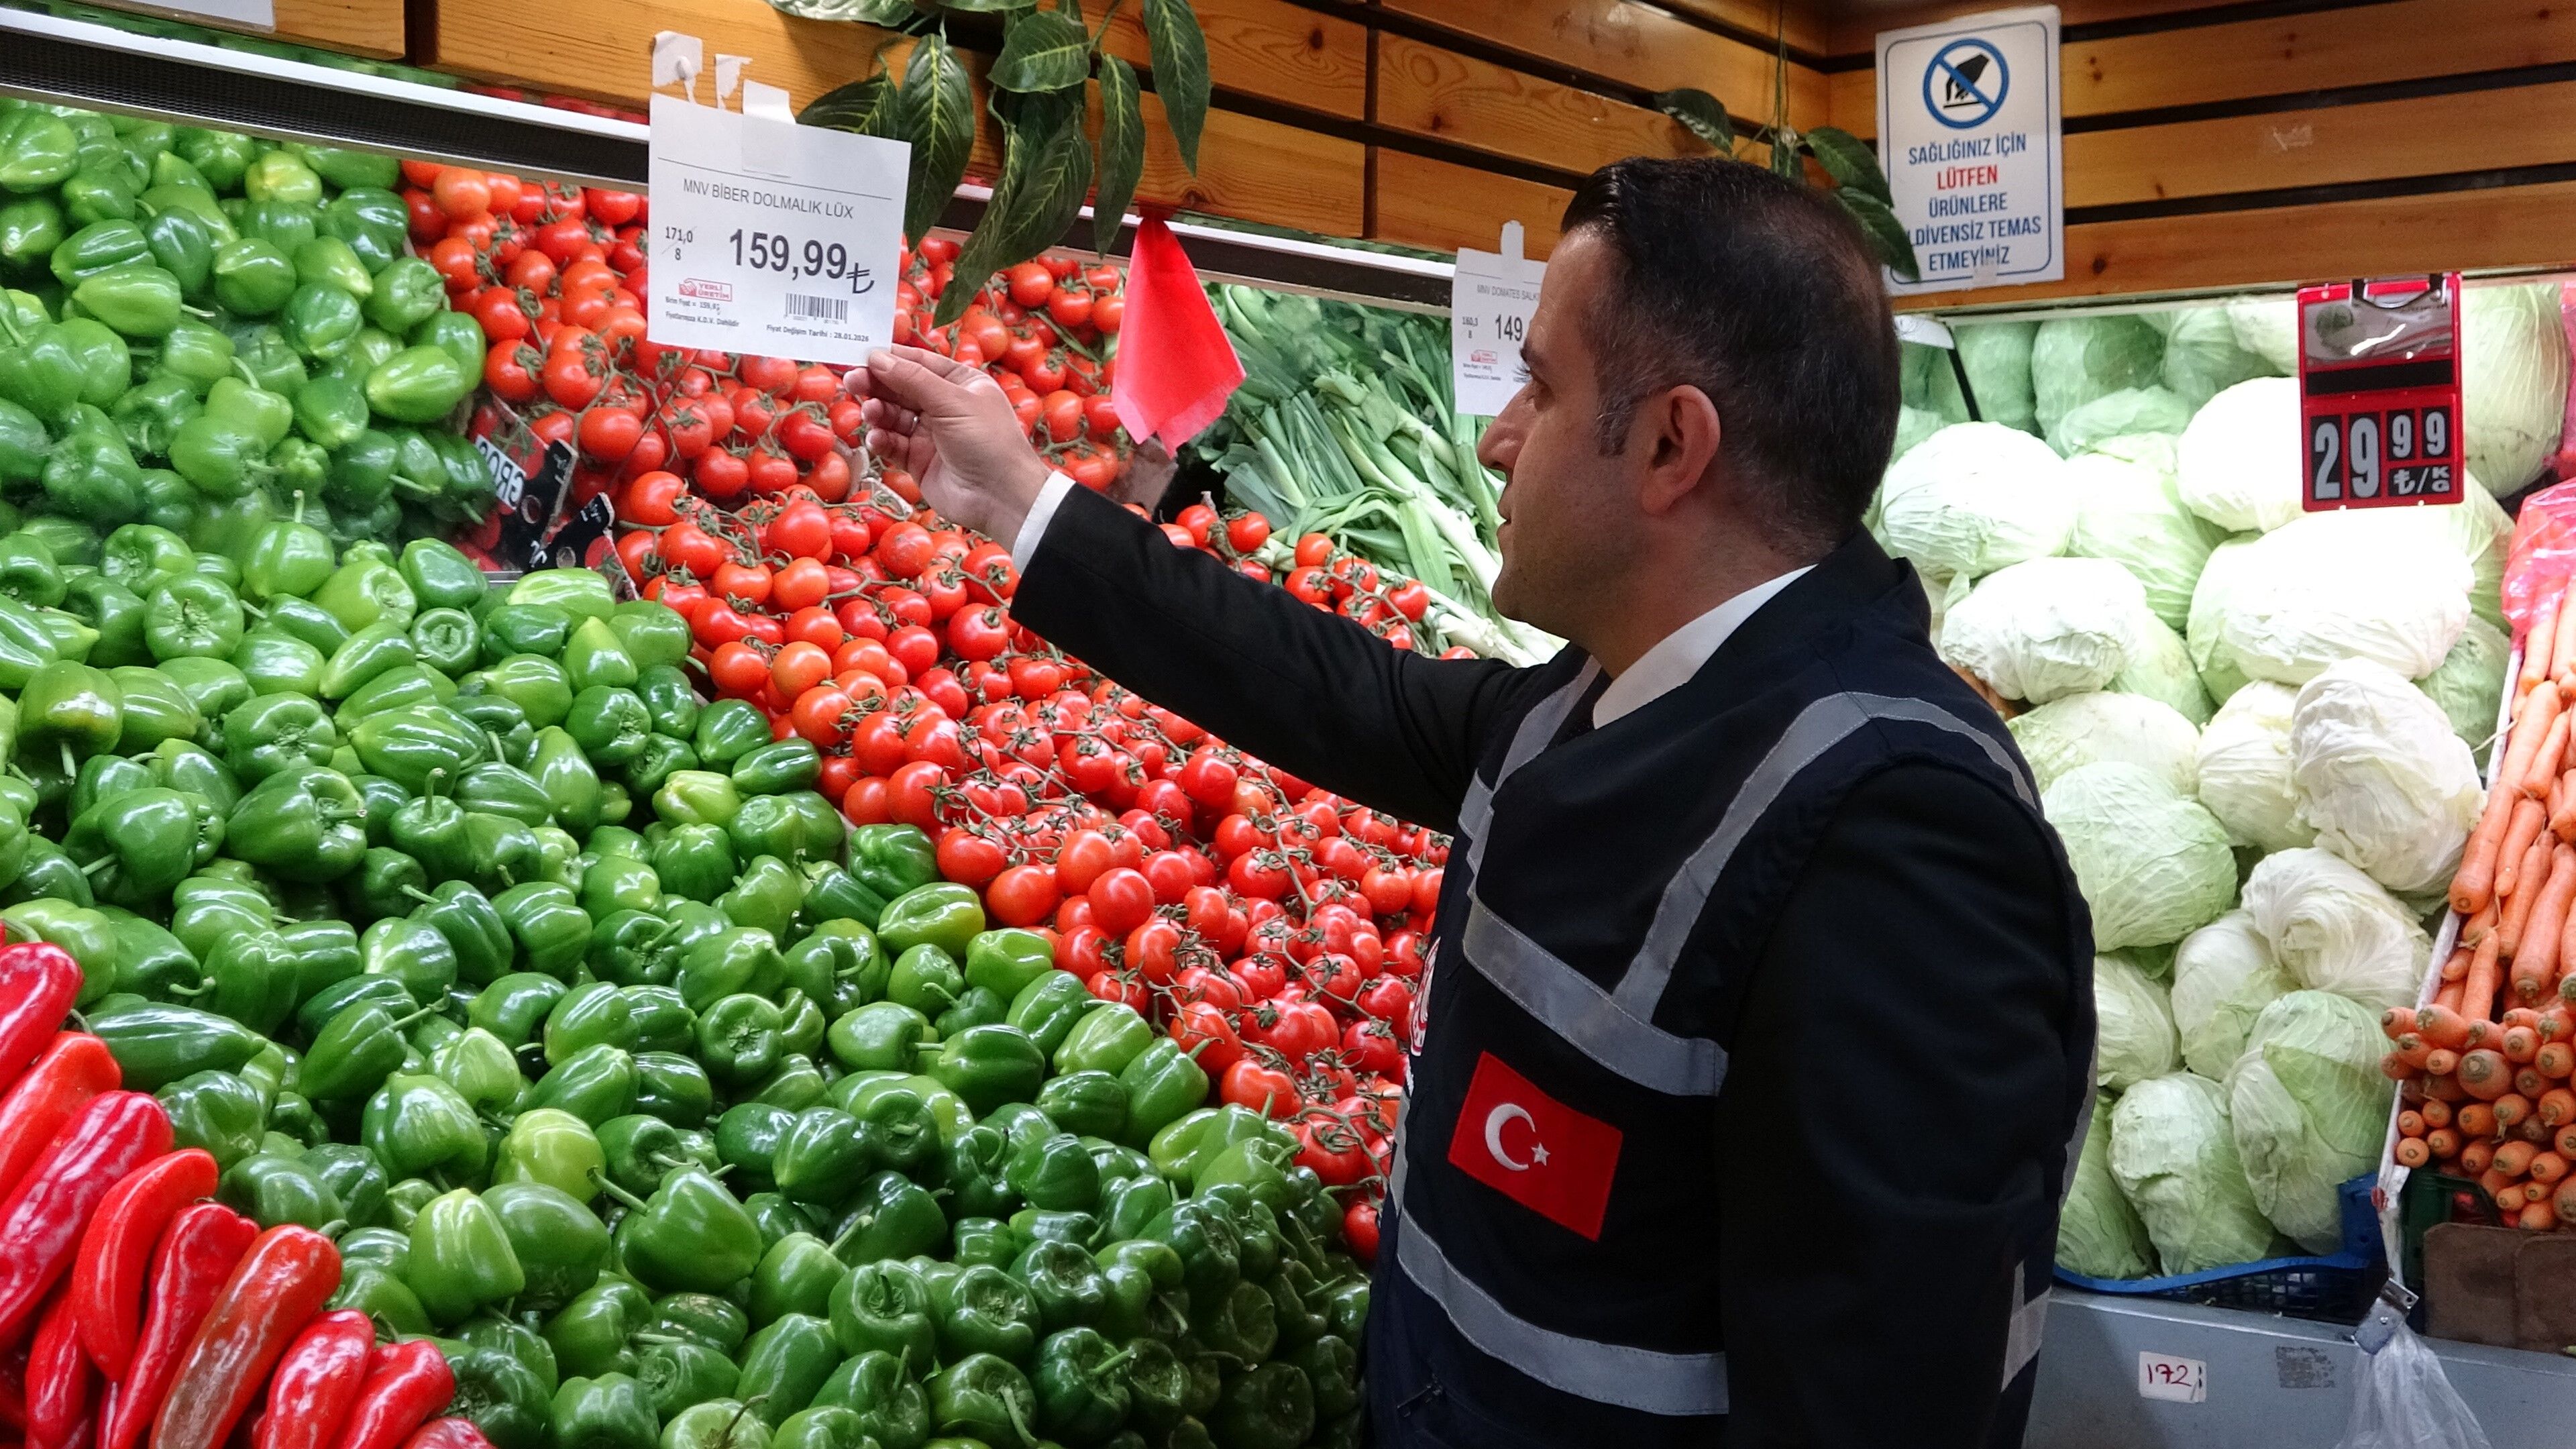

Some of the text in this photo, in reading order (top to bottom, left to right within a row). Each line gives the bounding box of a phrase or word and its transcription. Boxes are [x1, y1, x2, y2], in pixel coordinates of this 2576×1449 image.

[1909, 131, 2027, 165] SAĞLIĞINIZ İÇİN
[1937, 164, 1998, 191] LÜTFEN
[683, 178, 854, 219] MNV BİBER DOLMALIK LÜX
[1929, 193, 2008, 218] ÜRÜNLERE
[665, 225, 694, 245] 171,0
[1907, 215, 2042, 247] LDİVENSİZ TEMAS
[674, 247, 681, 261] 8
[1929, 243, 2010, 272] ETMEYİNİZ
[2147, 1363, 2192, 1387] 172
